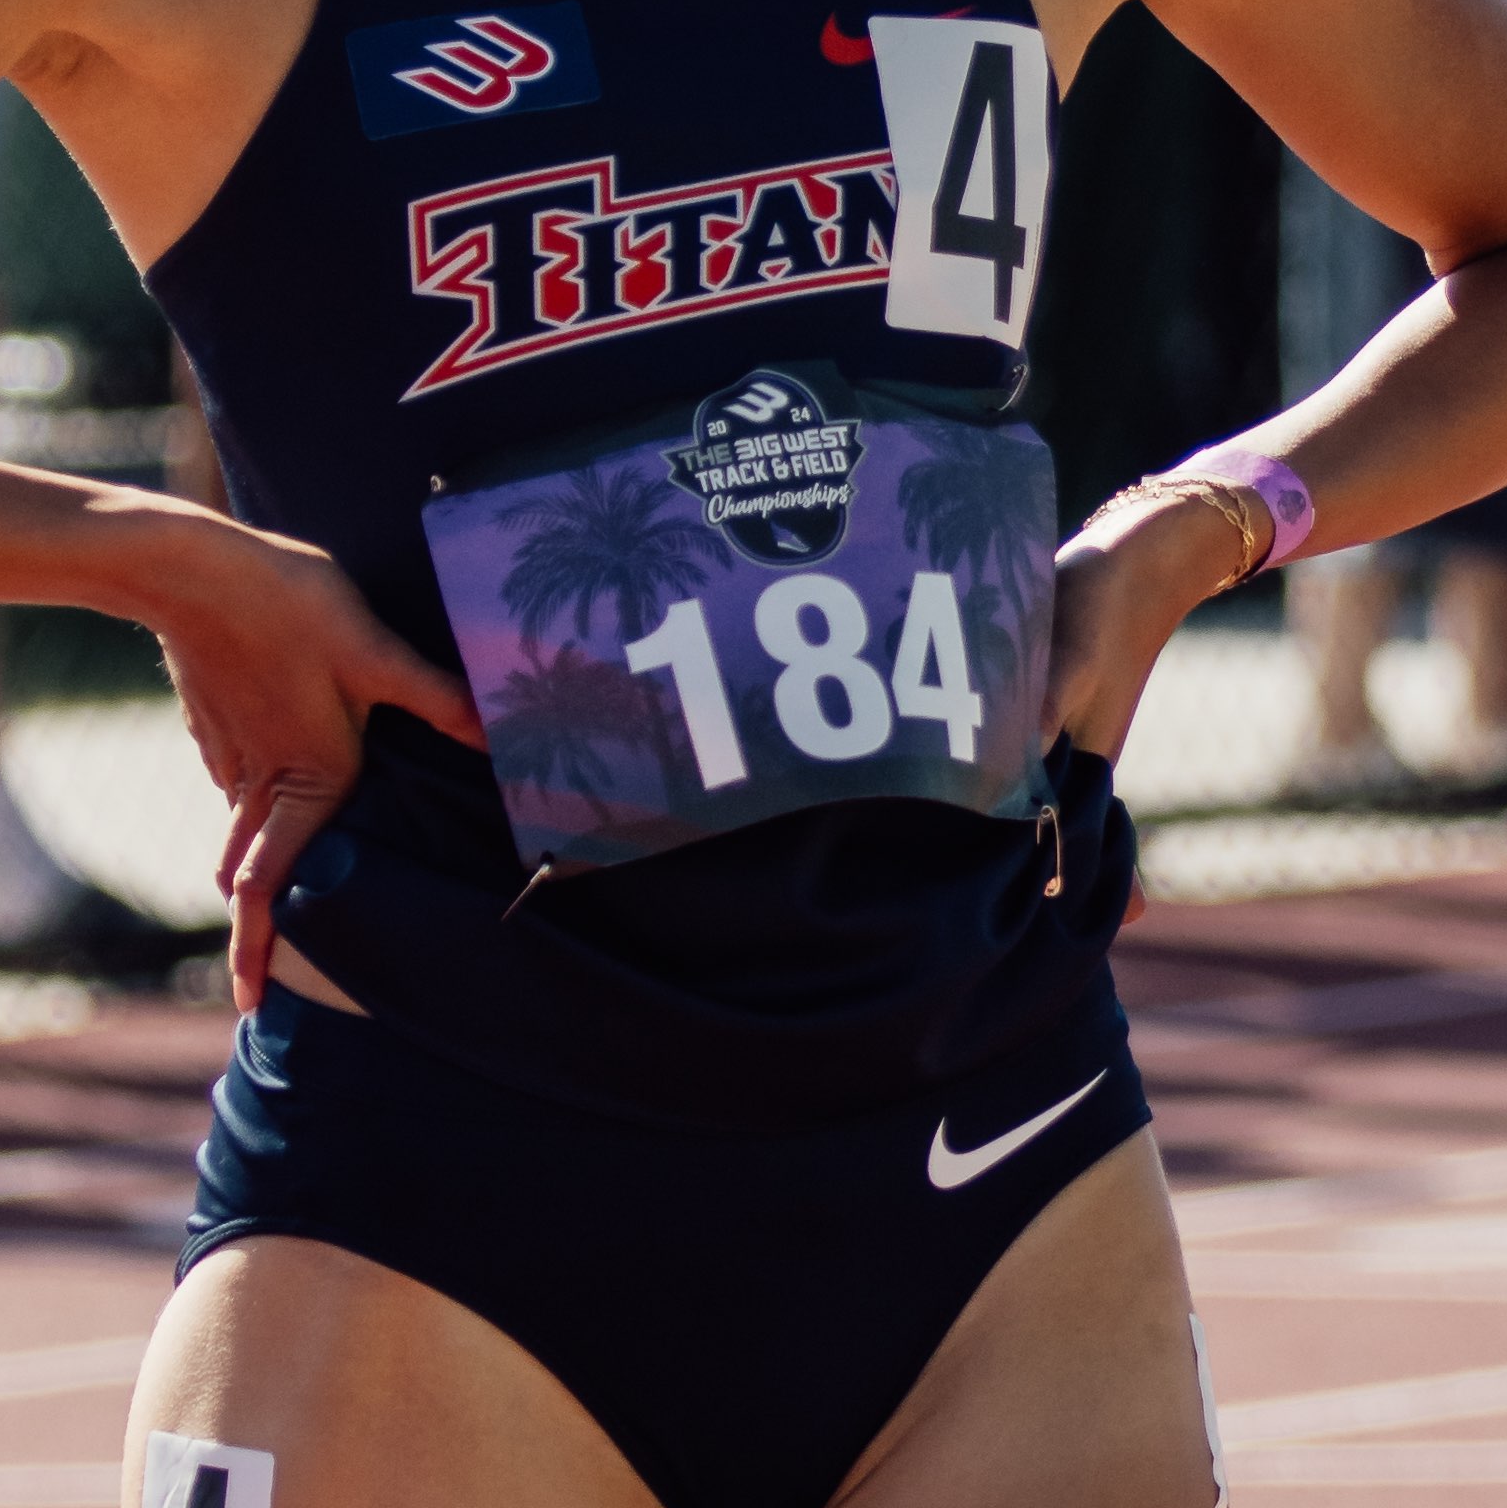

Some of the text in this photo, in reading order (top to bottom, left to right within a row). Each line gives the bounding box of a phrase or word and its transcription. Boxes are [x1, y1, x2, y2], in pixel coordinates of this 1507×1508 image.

[929, 40, 1027, 325] 4
[707, 407, 811, 437] 20 24
[678, 426, 848, 471] THE BIG WEST
[695, 450, 848, 492] TRACK & FIELD
[707, 482, 851, 523] Championships
[624, 571, 983, 790] 184
